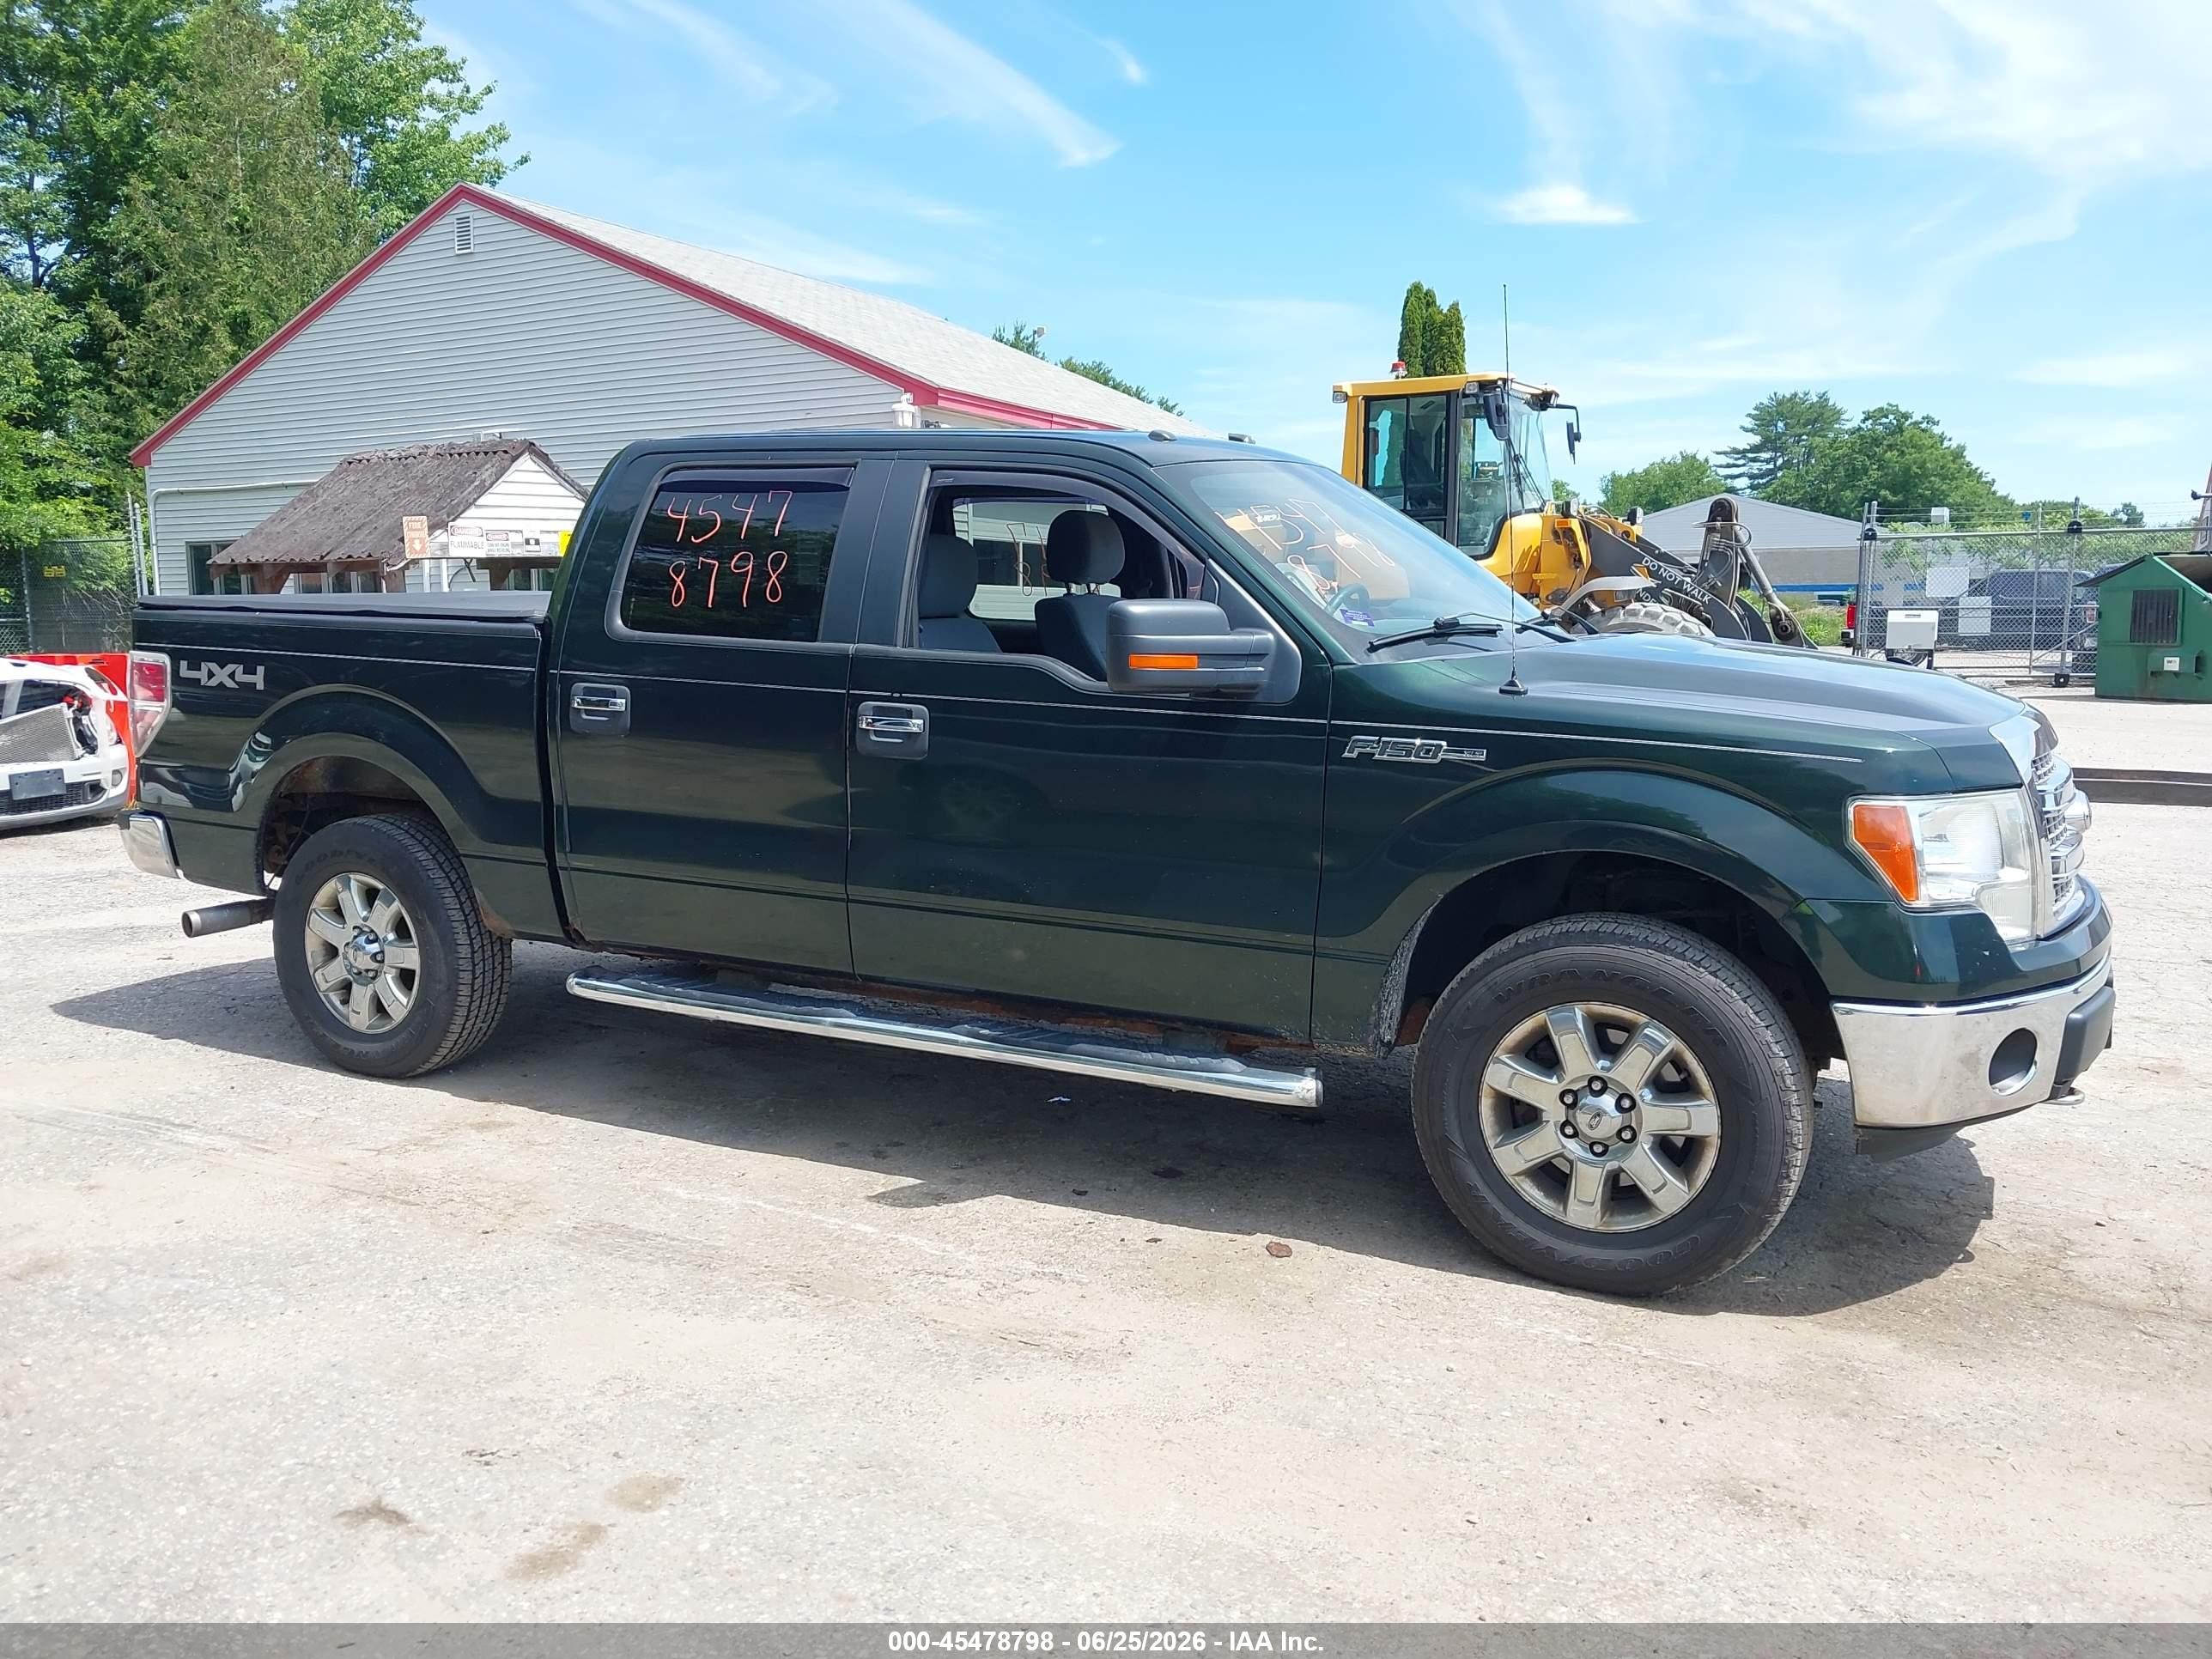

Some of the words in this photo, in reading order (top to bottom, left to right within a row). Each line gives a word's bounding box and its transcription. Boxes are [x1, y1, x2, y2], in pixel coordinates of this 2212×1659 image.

[666, 489, 793, 544] 4547
[1213, 498, 1346, 550] 4547
[450, 540, 484, 550] FLAMMABLE
[669, 550, 789, 609] 8798
[1642, 557, 1658, 571] DO
[1658, 568, 1682, 585] NOT
[1683, 582, 1711, 605] WALK
